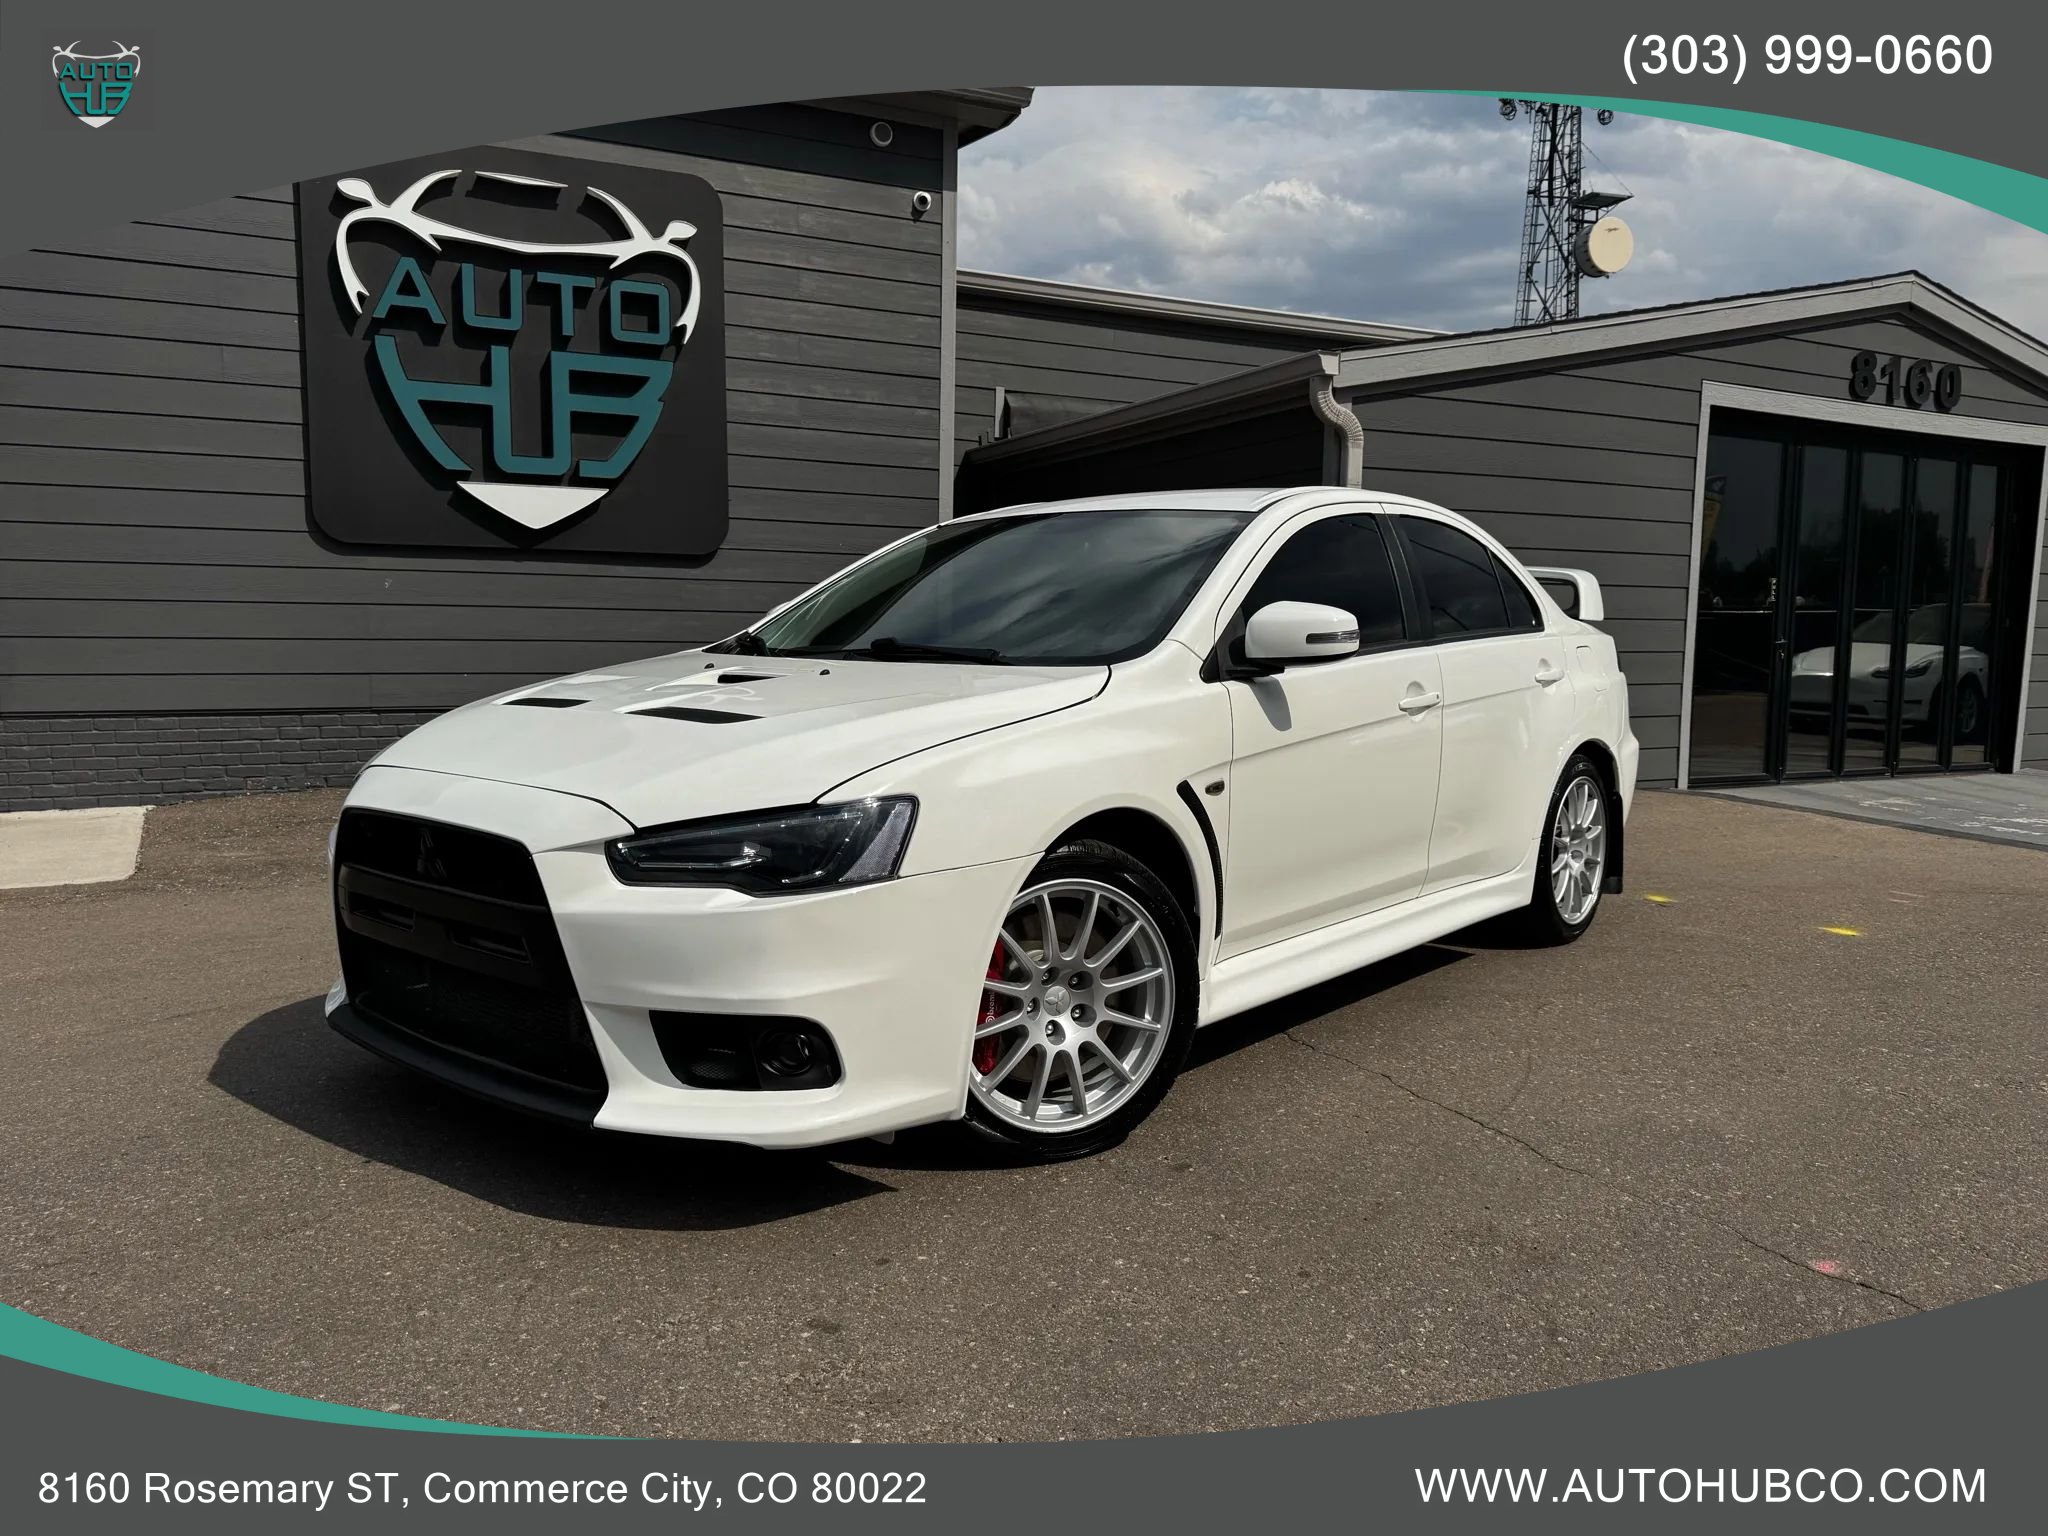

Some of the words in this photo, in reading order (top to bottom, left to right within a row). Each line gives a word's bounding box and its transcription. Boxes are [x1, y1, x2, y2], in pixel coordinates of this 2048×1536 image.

[372, 257, 671, 345] AUTO
[374, 335, 673, 479] HUB
[1849, 350, 1961, 413] 8160
